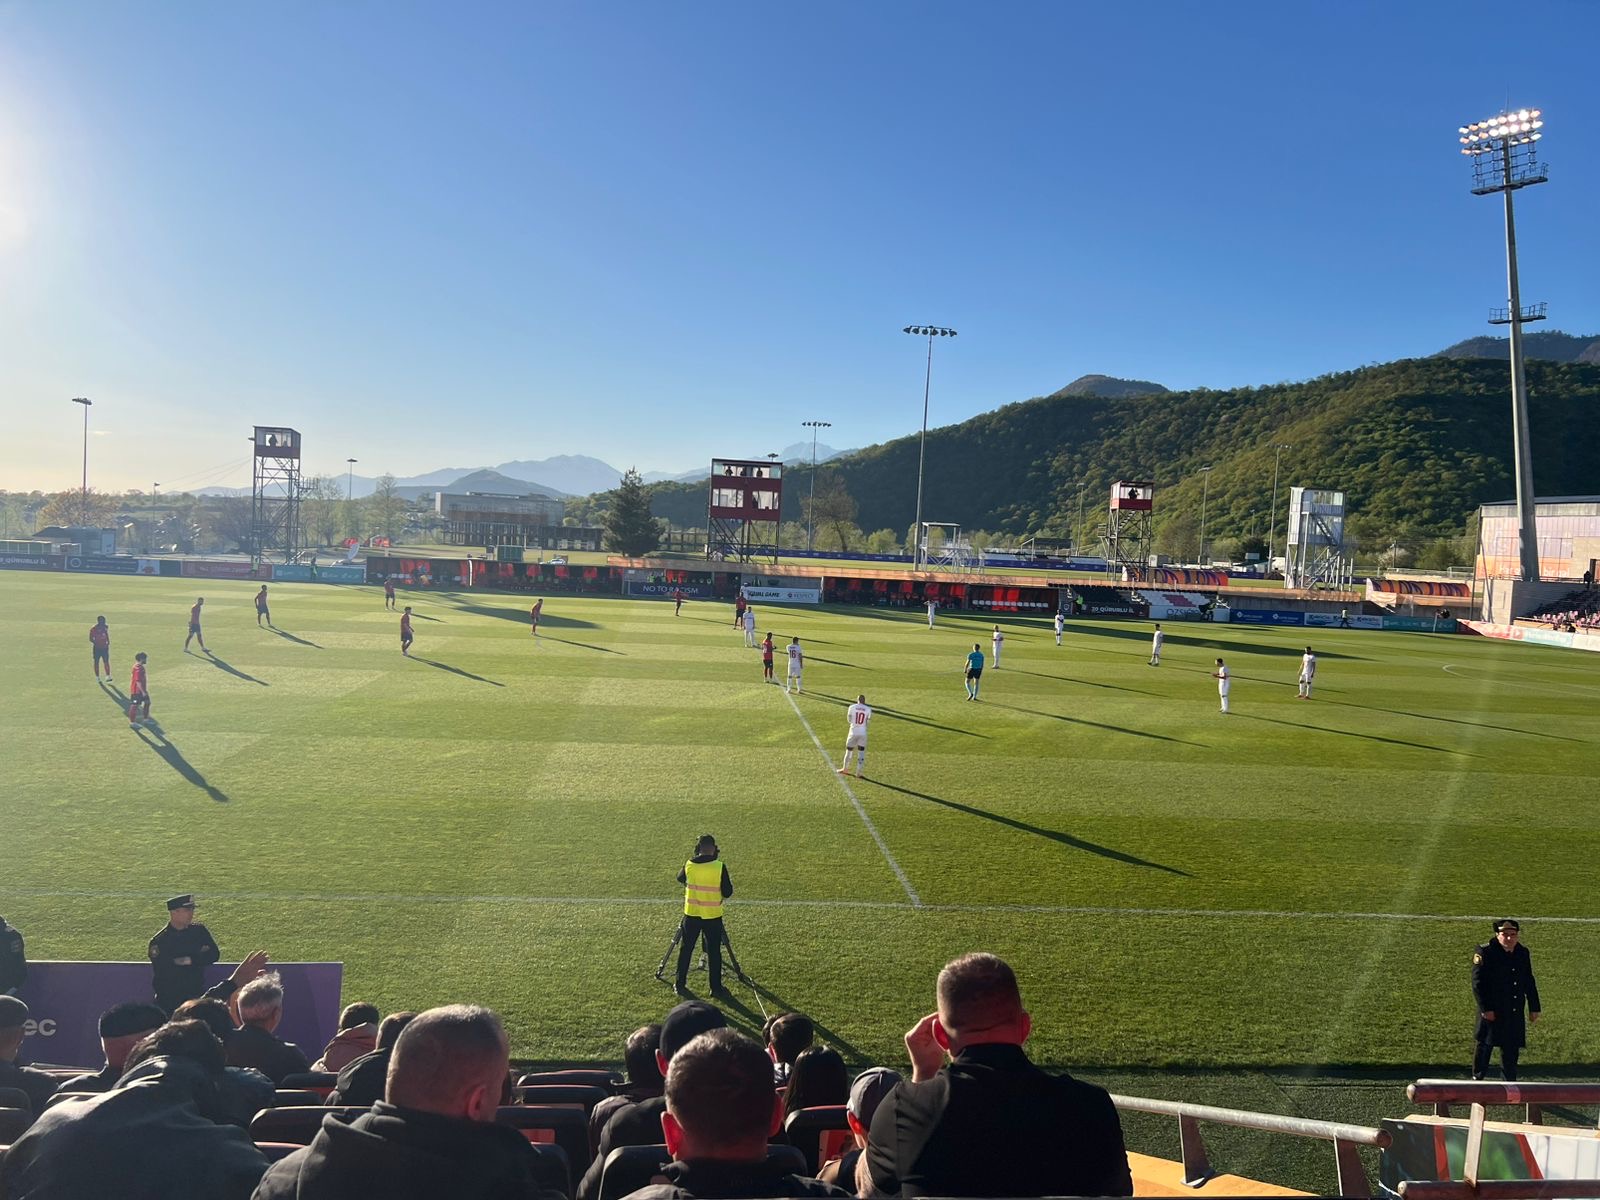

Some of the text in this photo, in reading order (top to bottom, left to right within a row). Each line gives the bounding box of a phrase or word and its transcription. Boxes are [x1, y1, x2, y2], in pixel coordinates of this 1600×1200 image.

[642, 585, 698, 595] NO TO RACISM
[789, 649, 797, 659] 16
[855, 711, 865, 725] 10
